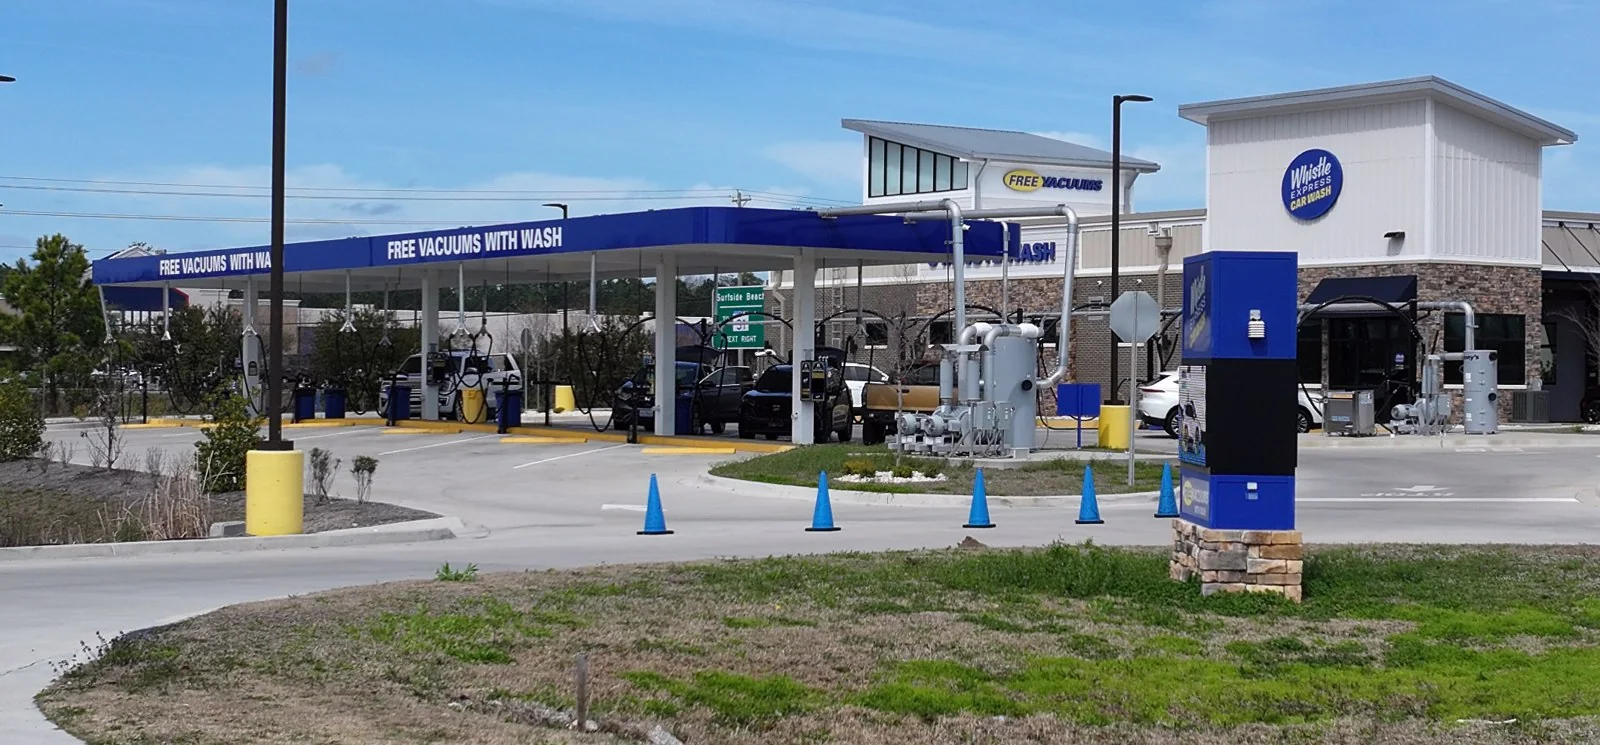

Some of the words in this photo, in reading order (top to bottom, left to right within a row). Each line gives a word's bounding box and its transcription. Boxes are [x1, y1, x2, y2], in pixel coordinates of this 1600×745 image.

[1009, 175, 1039, 187] FREE
[1041, 176, 1103, 191] VACUUMS
[1291, 156, 1331, 190] Whistle
[1290, 196, 1307, 211] CAR
[1307, 185, 1331, 204] WASH
[1291, 175, 1331, 199] EXPRESS
[387, 239, 416, 260] FREE
[419, 233, 481, 257] VACUUMS
[485, 230, 517, 252] WITH
[521, 226, 563, 249] WASH
[159, 258, 180, 276] FREE
[181, 255, 227, 274] VACUUMS
[229, 252, 254, 271] WITH
[717, 293, 743, 302] Surfside
[740, 335, 757, 343] RIGHT
